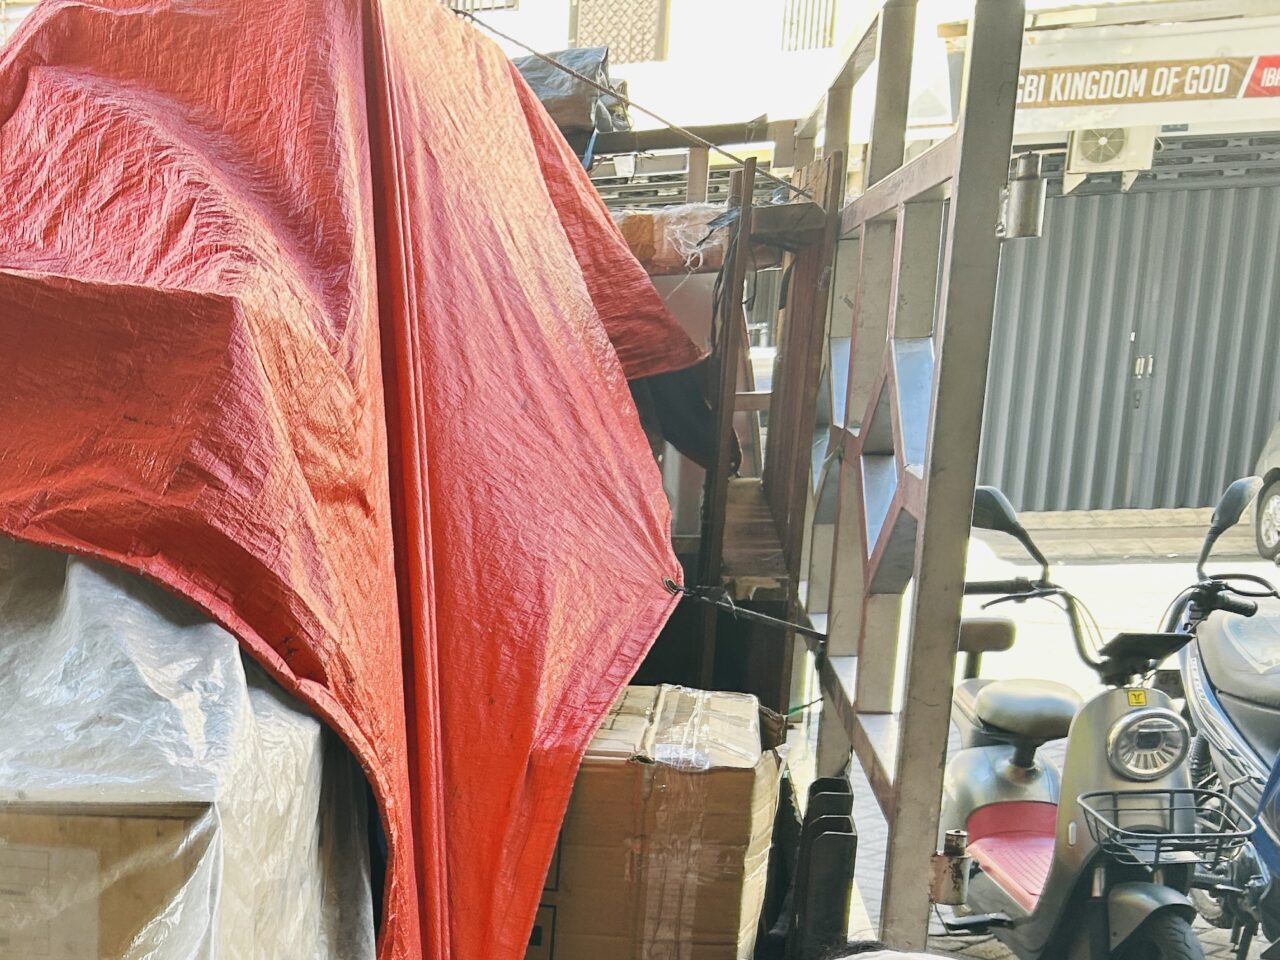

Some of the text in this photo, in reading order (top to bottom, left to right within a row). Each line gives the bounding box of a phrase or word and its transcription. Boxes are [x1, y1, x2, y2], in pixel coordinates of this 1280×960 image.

[1049, 68, 1148, 101] KINGDOM
[1151, 66, 1182, 97] OF
[1184, 63, 1231, 95] GOD
